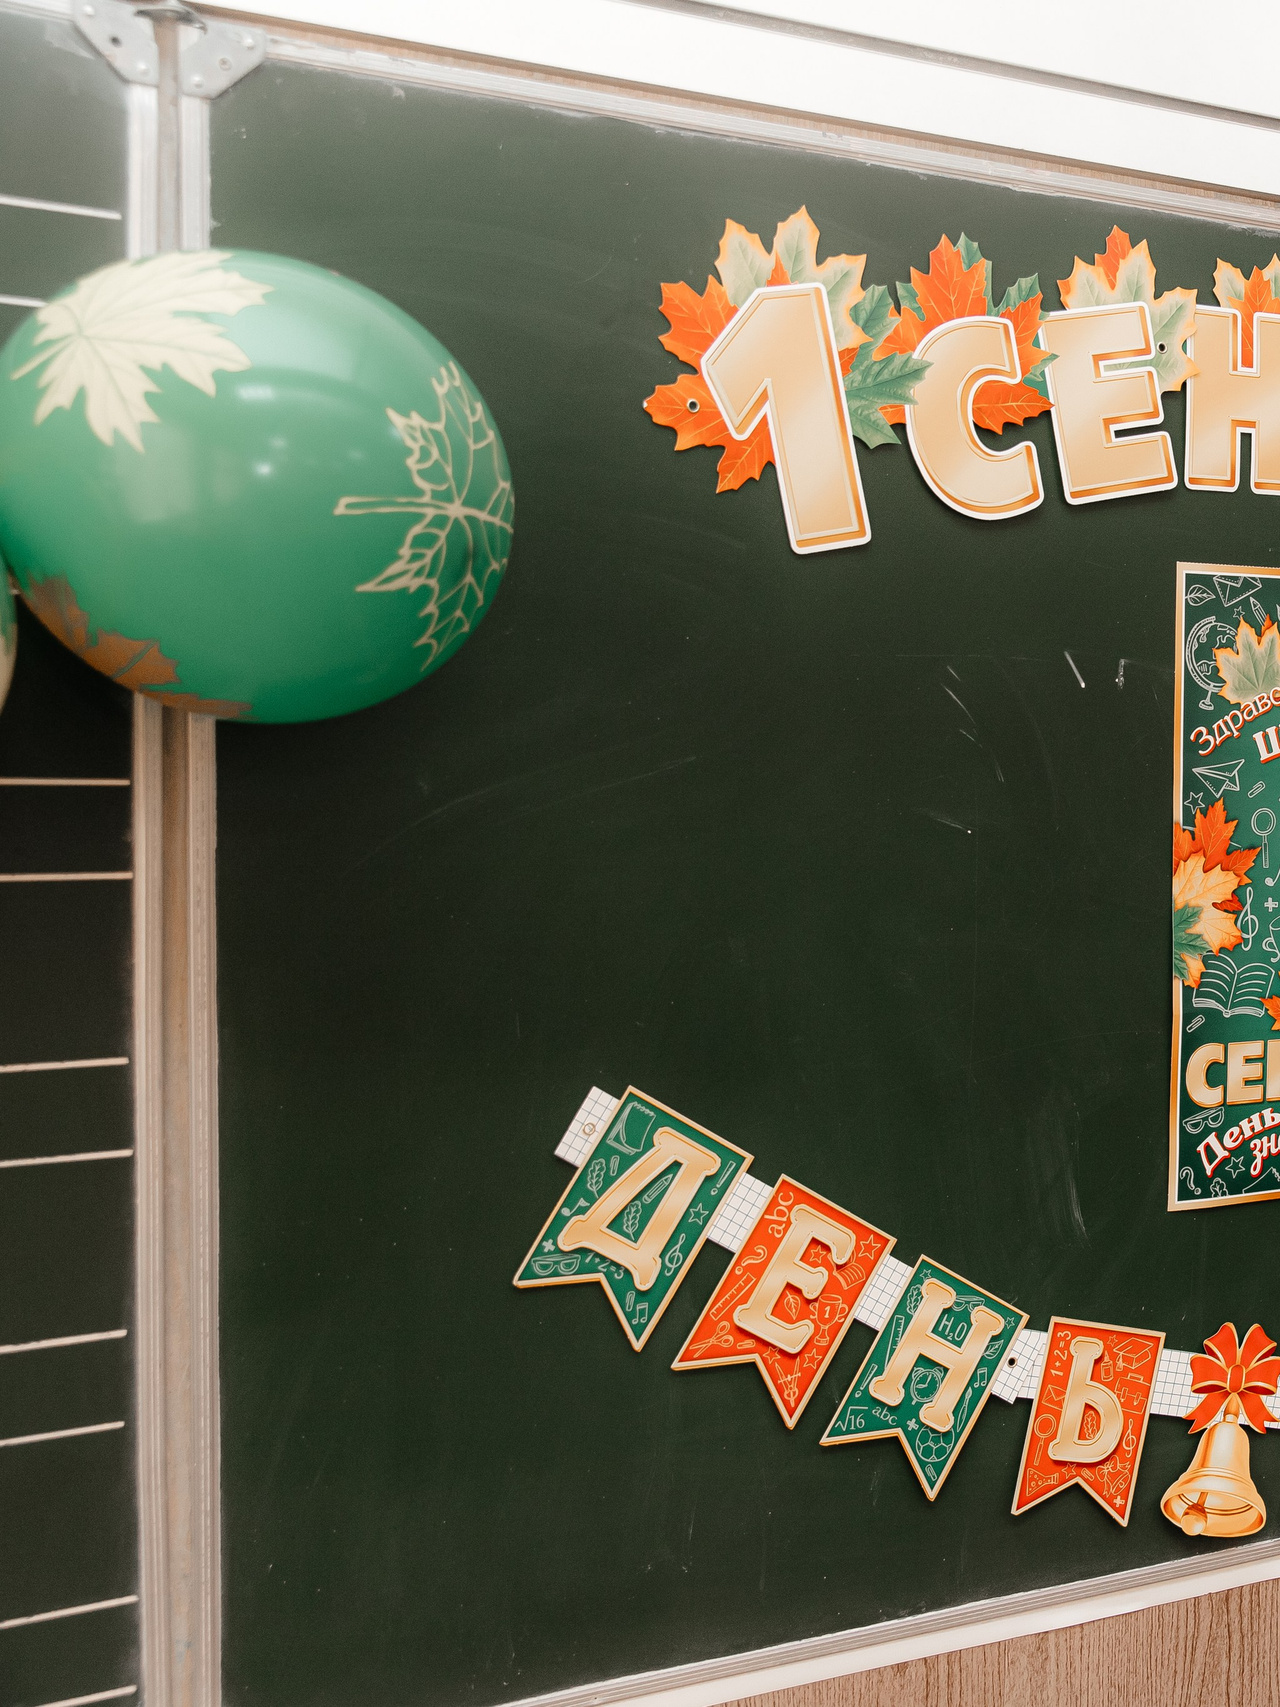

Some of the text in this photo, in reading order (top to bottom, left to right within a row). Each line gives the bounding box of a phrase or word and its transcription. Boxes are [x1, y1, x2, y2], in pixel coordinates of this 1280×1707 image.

[701, 282, 871, 554] 1
[764, 1191, 795, 1239] abc
[871, 1406, 898, 1427] abc
